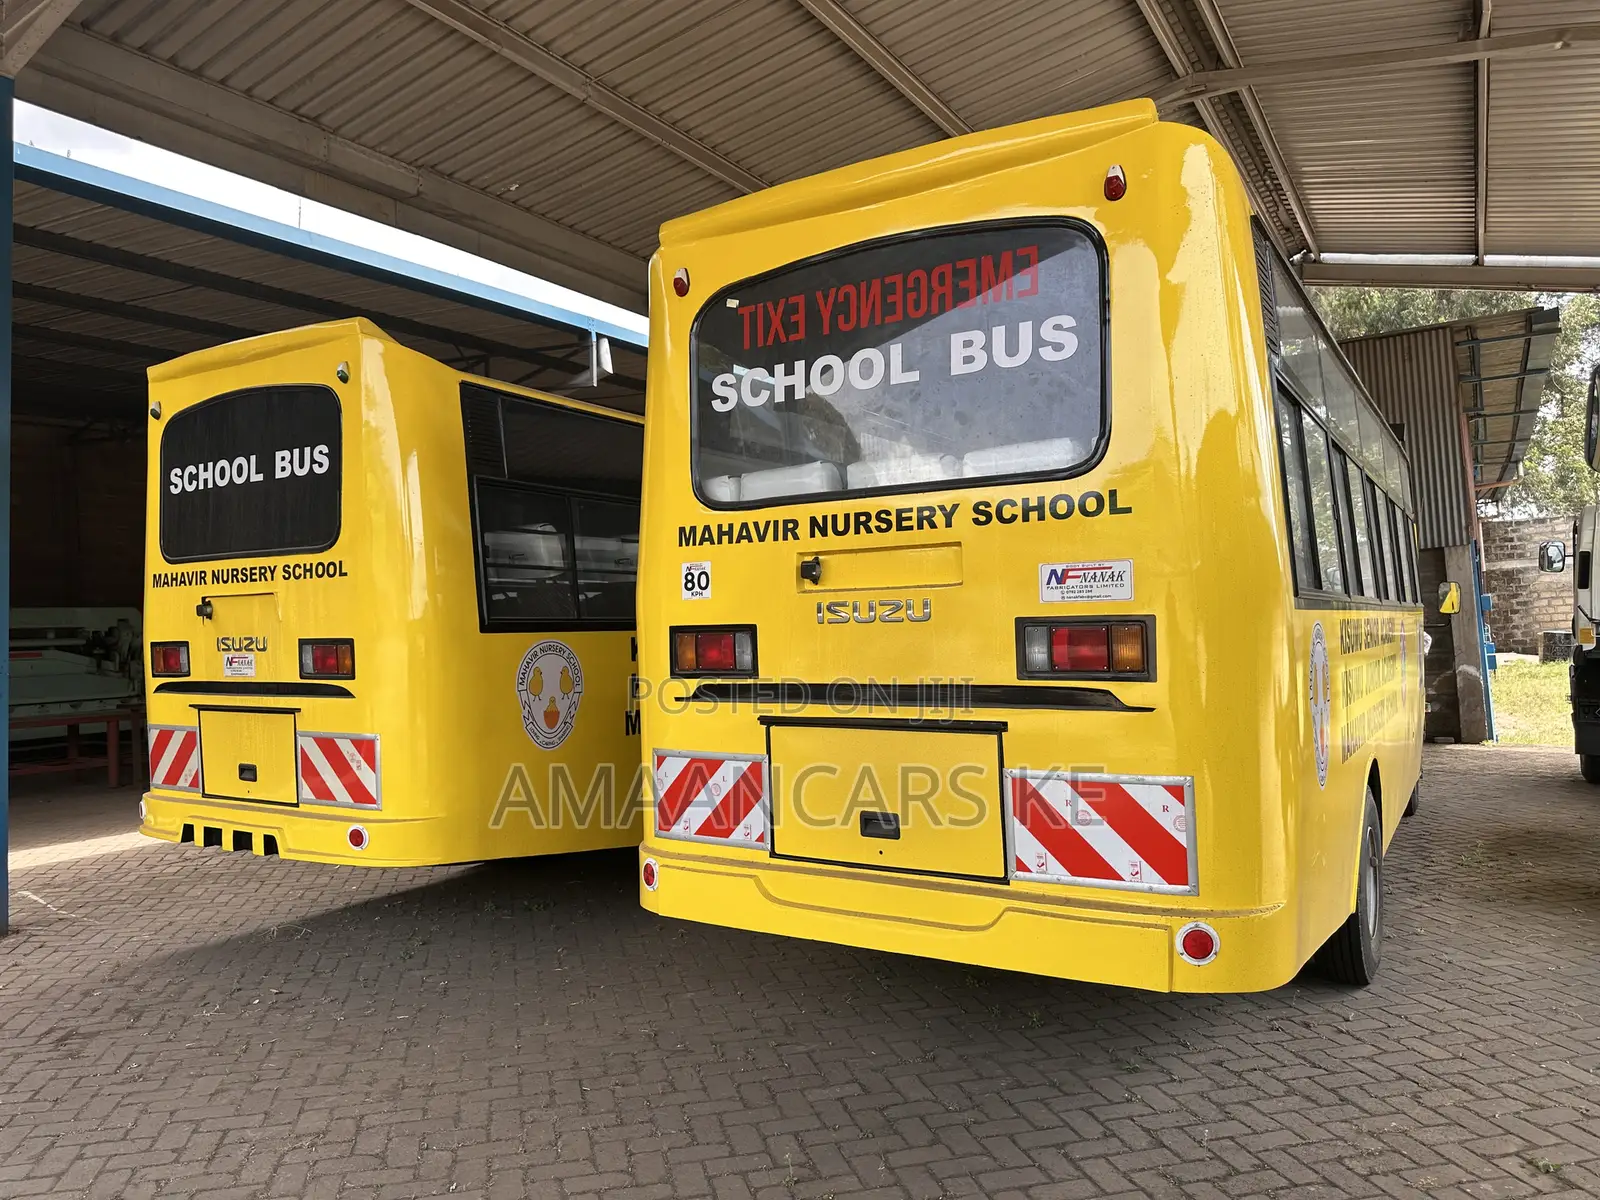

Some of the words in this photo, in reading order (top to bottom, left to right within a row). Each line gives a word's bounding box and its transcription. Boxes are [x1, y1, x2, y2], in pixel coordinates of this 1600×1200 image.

[710, 342, 921, 413] SCHOOL
[949, 314, 1079, 376] BUS
[169, 454, 264, 495] SCHOOL
[274, 444, 330, 480] BUS
[678, 518, 800, 547] MAHAVIR
[808, 504, 960, 538] NURSERY
[971, 488, 1133, 526] SCHOOL
[152, 570, 207, 588] MAHAVIR
[211, 564, 278, 585] NURSERY
[281, 559, 348, 581] SCHOOL
[684, 571, 710, 591] 80
[1080, 571, 1126, 583] NANAK
[817, 598, 932, 624] ISUZU
[216, 636, 268, 653] ISUZU
[519, 650, 539, 686] MAHAVIR
[539, 644, 566, 655] NURSERY
[566, 652, 580, 687] SCHOOL
[1065, 799, 1072, 807] R
[1162, 805, 1170, 813] R
